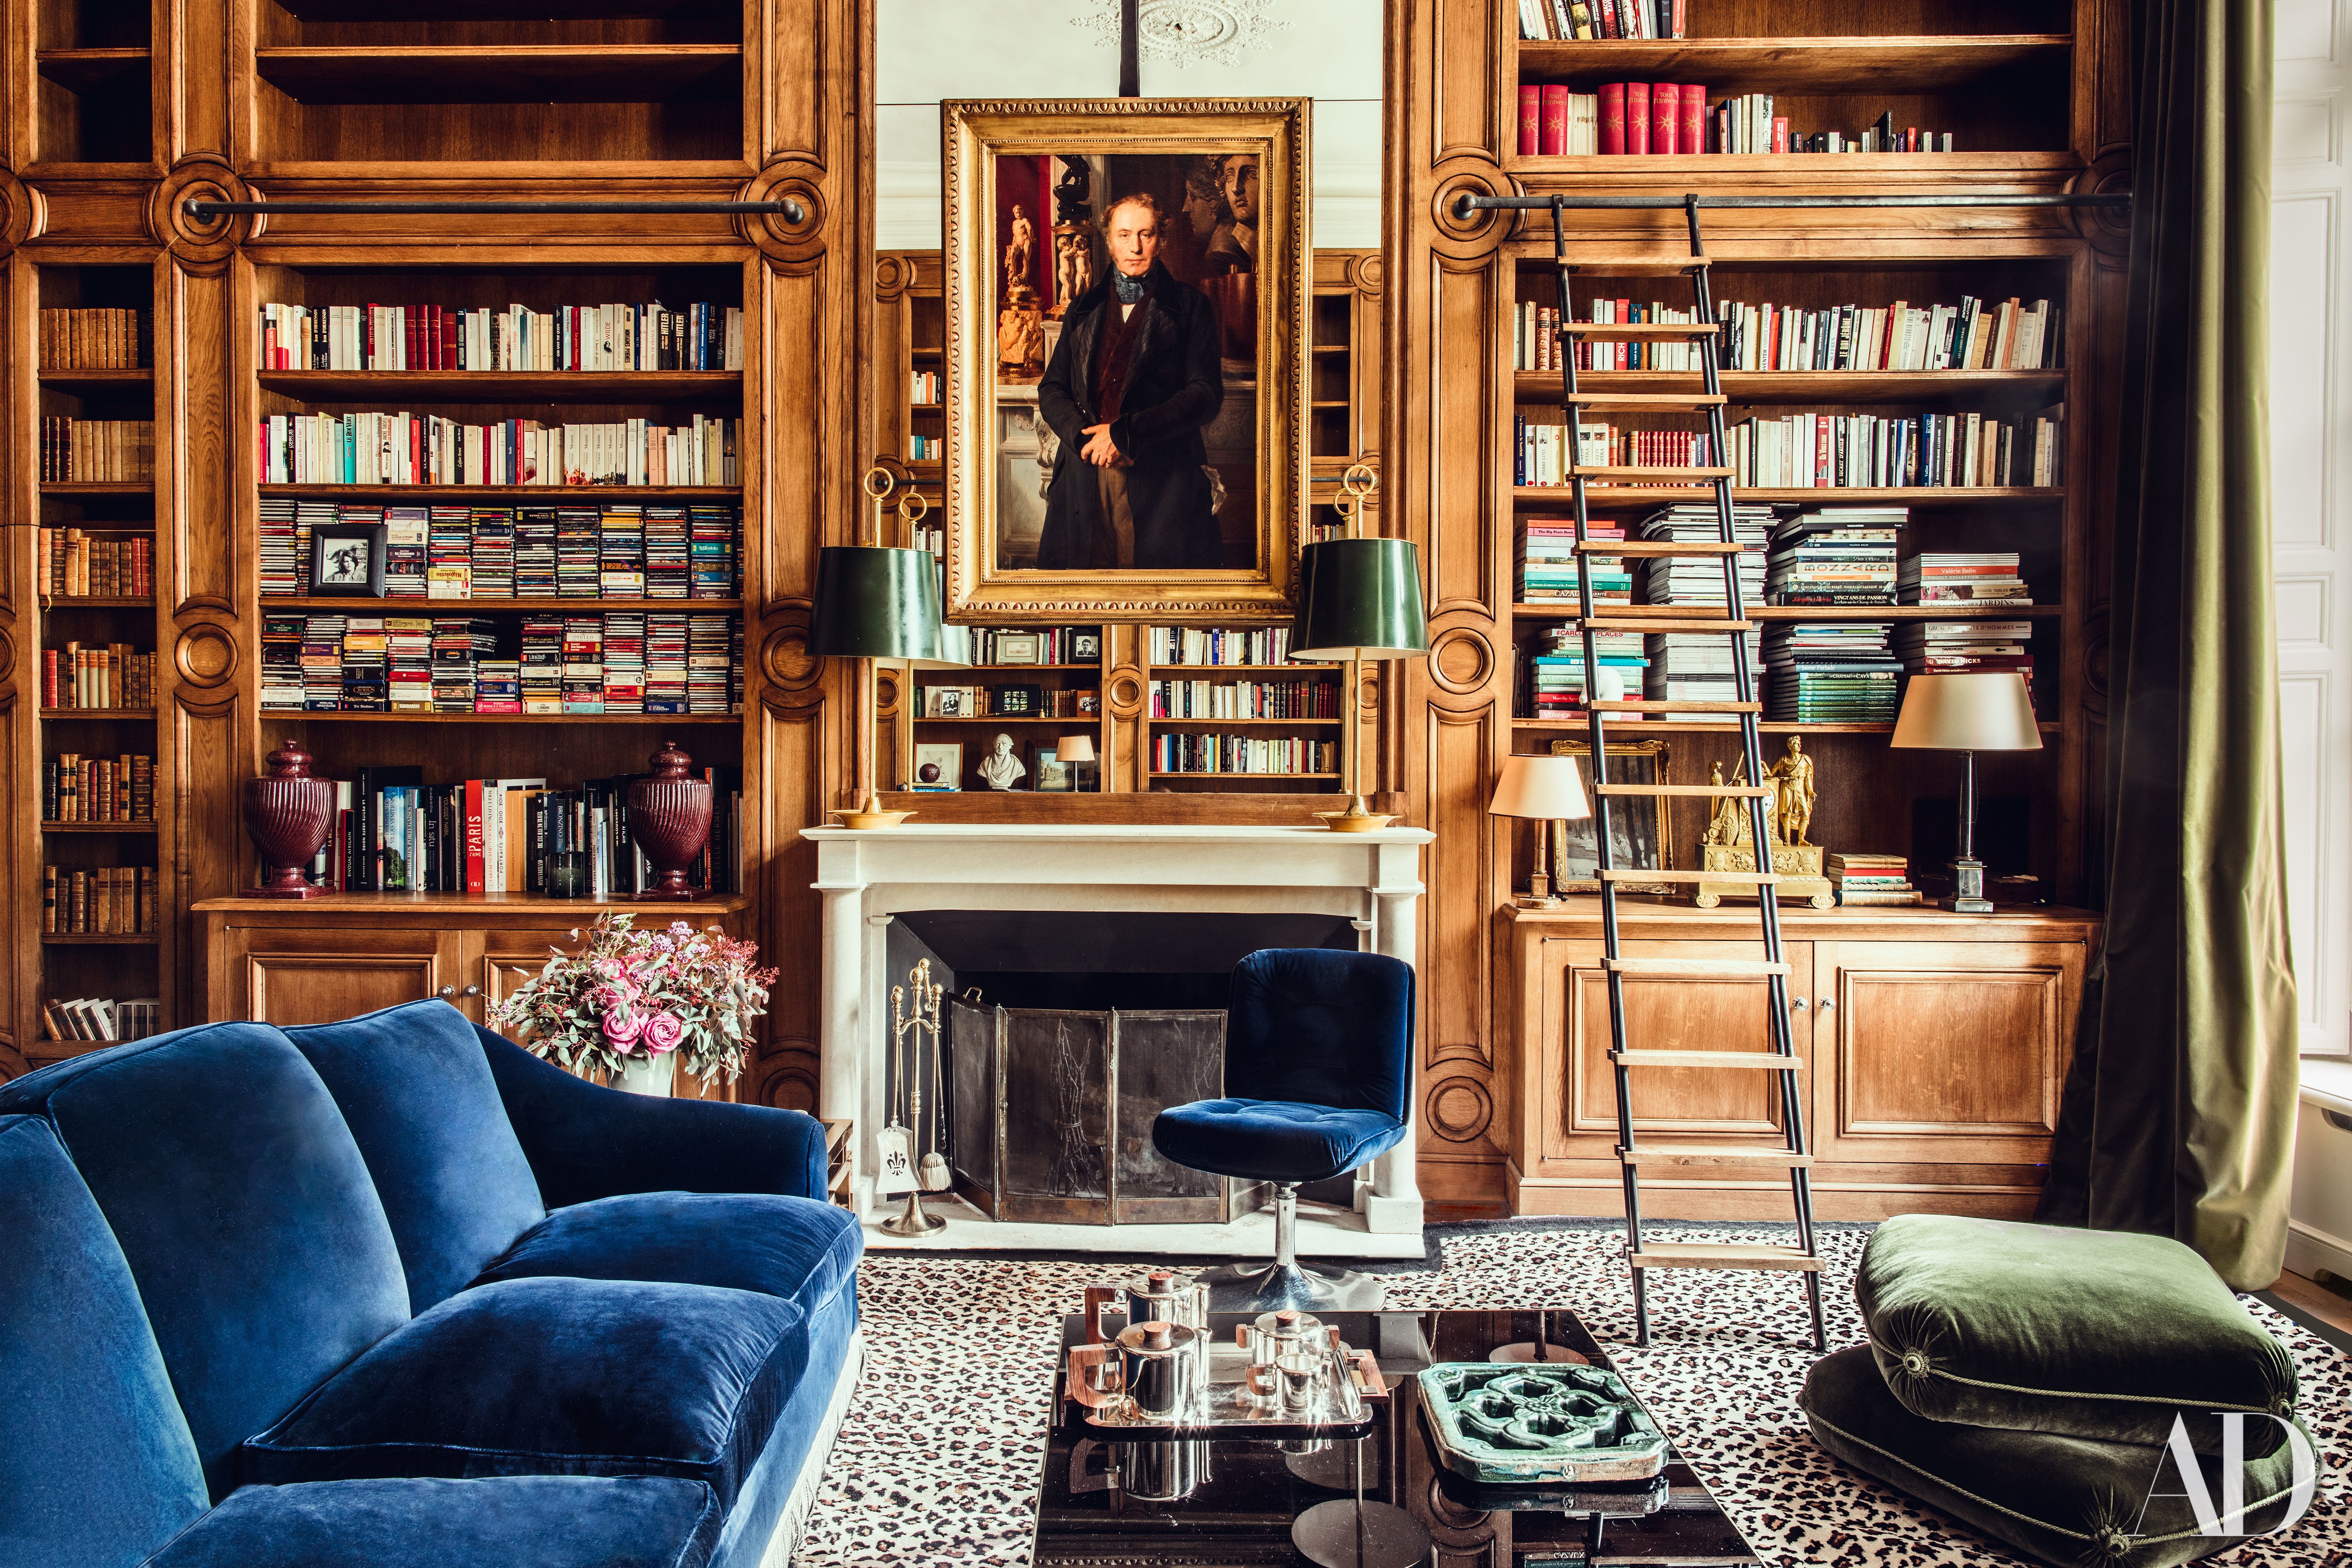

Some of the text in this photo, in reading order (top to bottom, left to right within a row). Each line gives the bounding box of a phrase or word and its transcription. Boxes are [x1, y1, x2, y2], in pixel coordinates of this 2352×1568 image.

[660, 313, 669, 335] HITLER
[1840, 318, 1851, 339] JÉRÔME
[1840, 340, 1849, 350] ROI
[428, 820, 436, 829] In
[468, 816, 481, 852] PARIS
